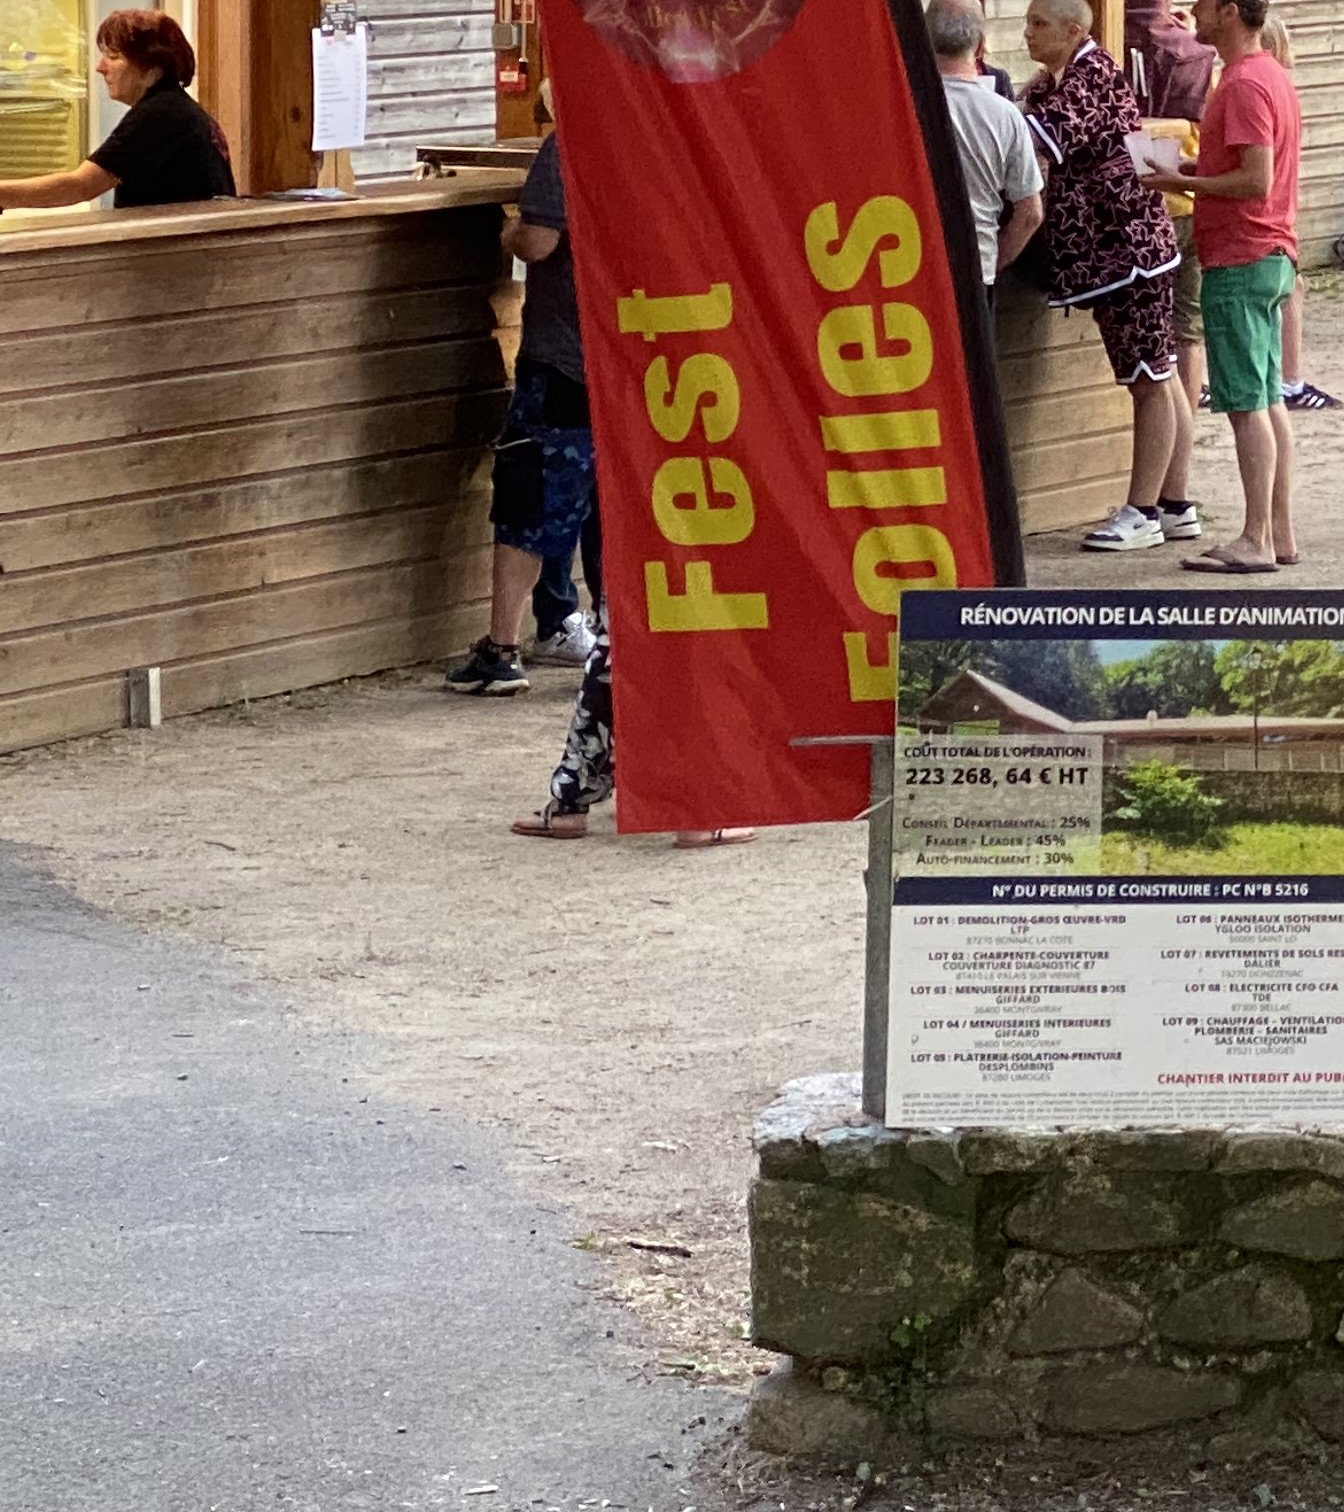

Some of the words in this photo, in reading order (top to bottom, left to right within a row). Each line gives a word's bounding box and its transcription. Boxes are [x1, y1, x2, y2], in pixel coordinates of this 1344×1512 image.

[616, 282, 769, 632] Fest
[961, 604, 1094, 625] RÉNOVATION
[1100, 607, 1124, 625] DE
[1129, 607, 1154, 625] LA
[1157, 607, 1215, 625] SALLE
[904, 744, 937, 758] COÛT
[942, 746, 981, 758] TOTAL
[984, 746, 1000, 757] DE
[905, 767, 945, 785] 223
[951, 767, 998, 788] 268,
[1006, 767, 1032, 785] 64
[1039, 767, 1052, 785] €
[1059, 767, 1088, 785] HT
[1059, 816, 1090, 828] 25%
[1035, 834, 1066, 846] 45%
[1044, 852, 1074, 864] 30%
[1014, 885, 1036, 897] DU
[1040, 884, 1094, 897] PERMIS
[1097, 884, 1116, 896] DE
[1119, 884, 1211, 896] CONSTRUIRE
[1222, 884, 1241, 896] PC
[1275, 884, 1309, 896] 5216
[913, 916, 934, 925] LOT
[1176, 915, 1196, 924] LOT
[1220, 915, 1281, 924] PANNEAUX
[1010, 926, 1030, 935] LTP
[1215, 925, 1251, 933] YGLOO
[1254, 925, 1311, 933] ISOLATION
[928, 951, 950, 960] LOT
[972, 951, 1110, 960] CHARPENTE-COUVERTURE
[1160, 950, 1181, 959] LOT
[1184, 950, 1196, 959] 07
[1204, 950, 1279, 959] REVETEMENTS
[1281, 950, 1295, 959] DE
[1298, 950, 1324, 959] SOLS
[942, 961, 1012, 970] COUVERTURE
[1014, 961, 1081, 970] DIAGNOSTIC
[1244, 960, 1281, 968] DALIER
[910, 986, 931, 994] LOT
[955, 986, 1026, 994] MENUISERIES
[1029, 986, 1099, 994] EXTERIEURES
[1184, 984, 1206, 992] LOT
[1229, 984, 1293, 992] ELECTRICITE
[1295, 984, 1316, 992] CFO
[1318, 984, 1339, 992] CFA
[996, 996, 1040, 1004] GIFFARD
[1252, 993, 1271, 1002] TDE
[923, 1020, 944, 1029] LOT
[946, 1020, 960, 1029] 04
[969, 1020, 1041, 1029] MENUISERIES
[1043, 1020, 1111, 1029] INTERIEURES
[1162, 1017, 1183, 1026] LOT
[1206, 1017, 1270, 1026] CHAUFFAGE
[994, 1030, 1040, 1038] GIFFARD
[1194, 1027, 1255, 1036] PLOMBERIE
[1266, 1027, 1328, 1036] SANITAIRES
[1214, 1037, 1232, 1045] SAS
[910, 1052, 932, 1062] LOT
[1157, 1073, 1224, 1084] CHANTIER
[1228, 1073, 1289, 1083] INTERDIT
[1293, 1072, 1312, 1083] AU
